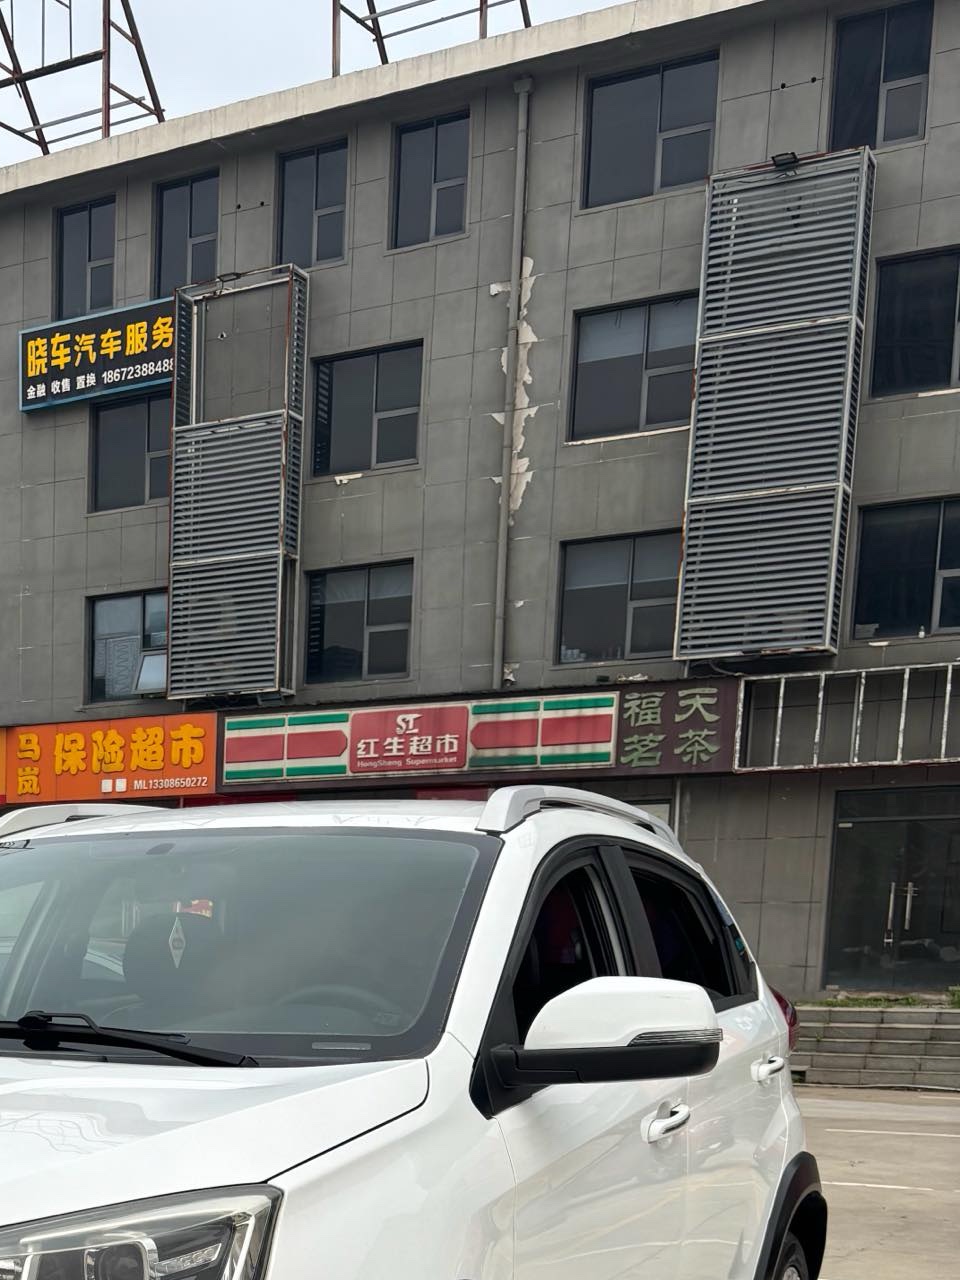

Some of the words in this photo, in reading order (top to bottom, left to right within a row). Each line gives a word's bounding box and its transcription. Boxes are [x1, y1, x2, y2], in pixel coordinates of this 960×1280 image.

[27, 316, 174, 378] 晓车汽车服务
[26, 384, 46, 400] 金融
[50, 378, 71, 395] 收售
[76, 373, 96, 390] 置换
[54, 723, 206, 775] 保险超市
[356, 733, 460, 759] 红生超市
